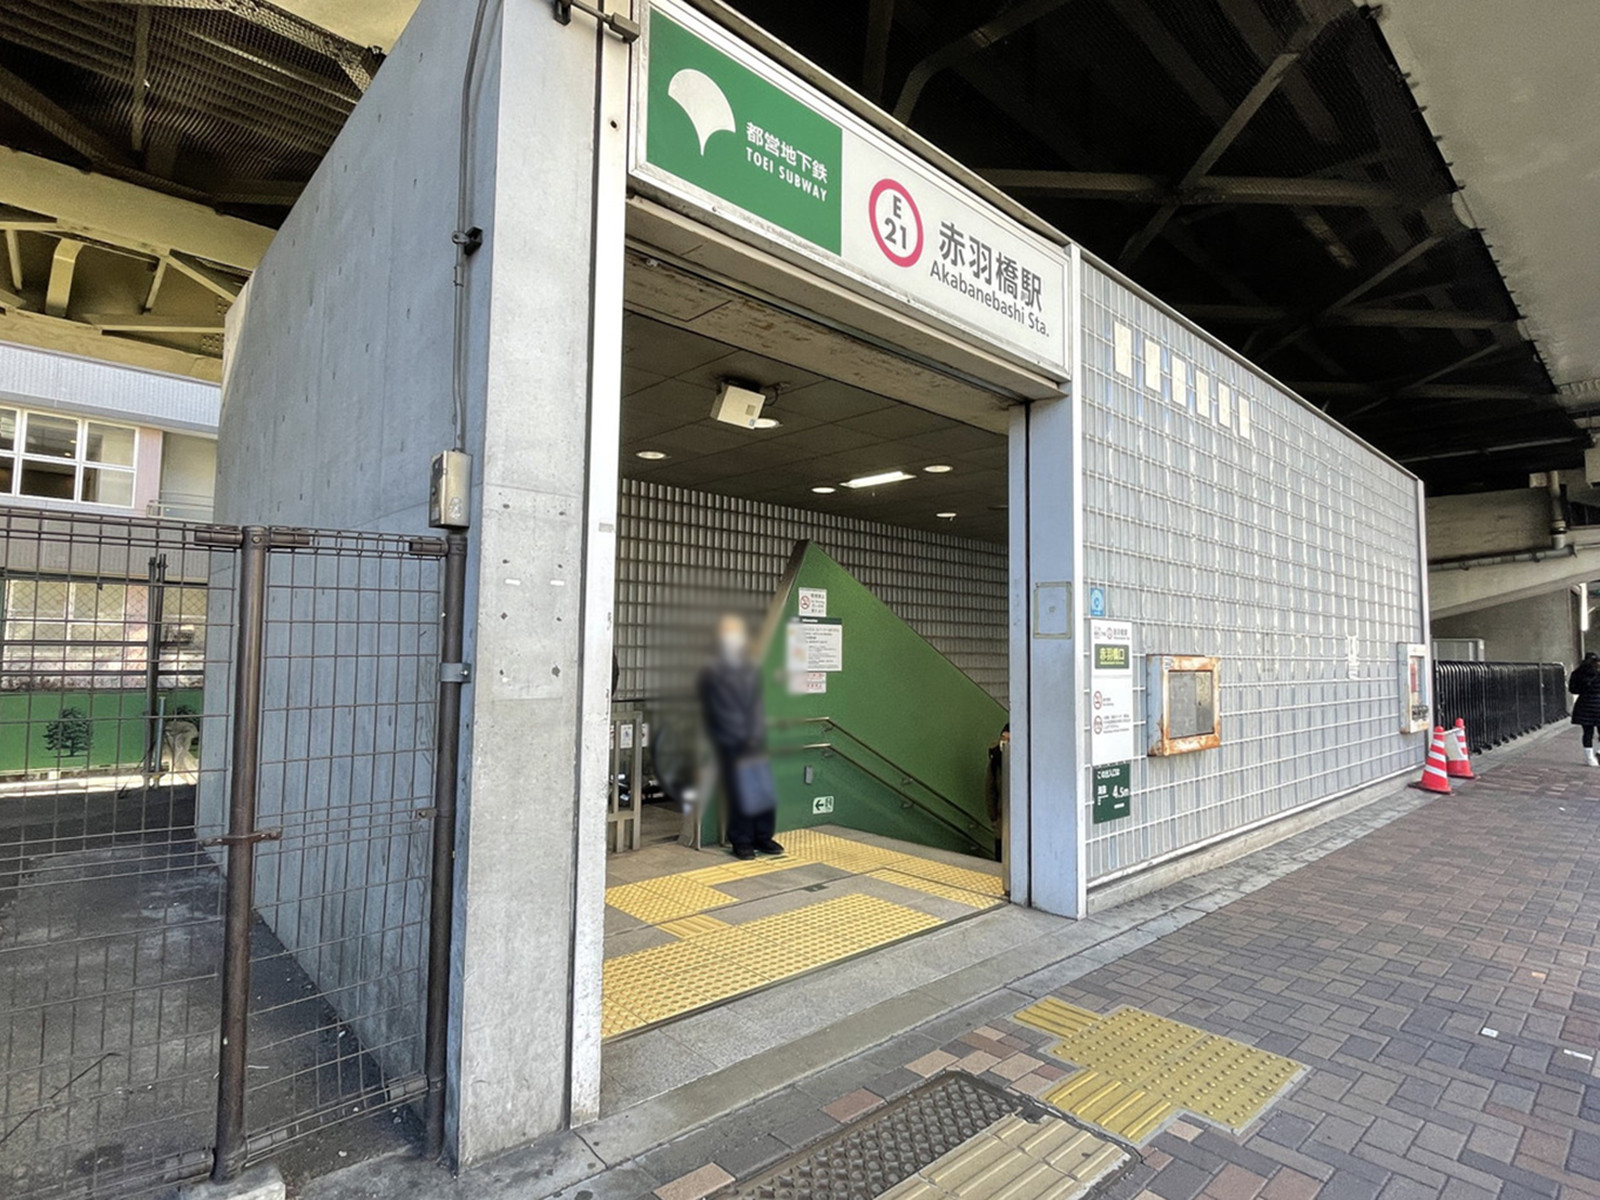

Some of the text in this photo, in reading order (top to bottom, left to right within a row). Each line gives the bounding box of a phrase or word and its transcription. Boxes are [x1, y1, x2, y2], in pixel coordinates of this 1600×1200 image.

[746, 122, 828, 184] 都営地下鉄
[746, 146, 828, 202] TOEI SUBWAY
[884, 217, 907, 249] 21
[892, 195, 902, 220] E
[938, 220, 1042, 312] 赤羽橋駅
[930, 260, 1050, 337] Akabanebashi Sta.
